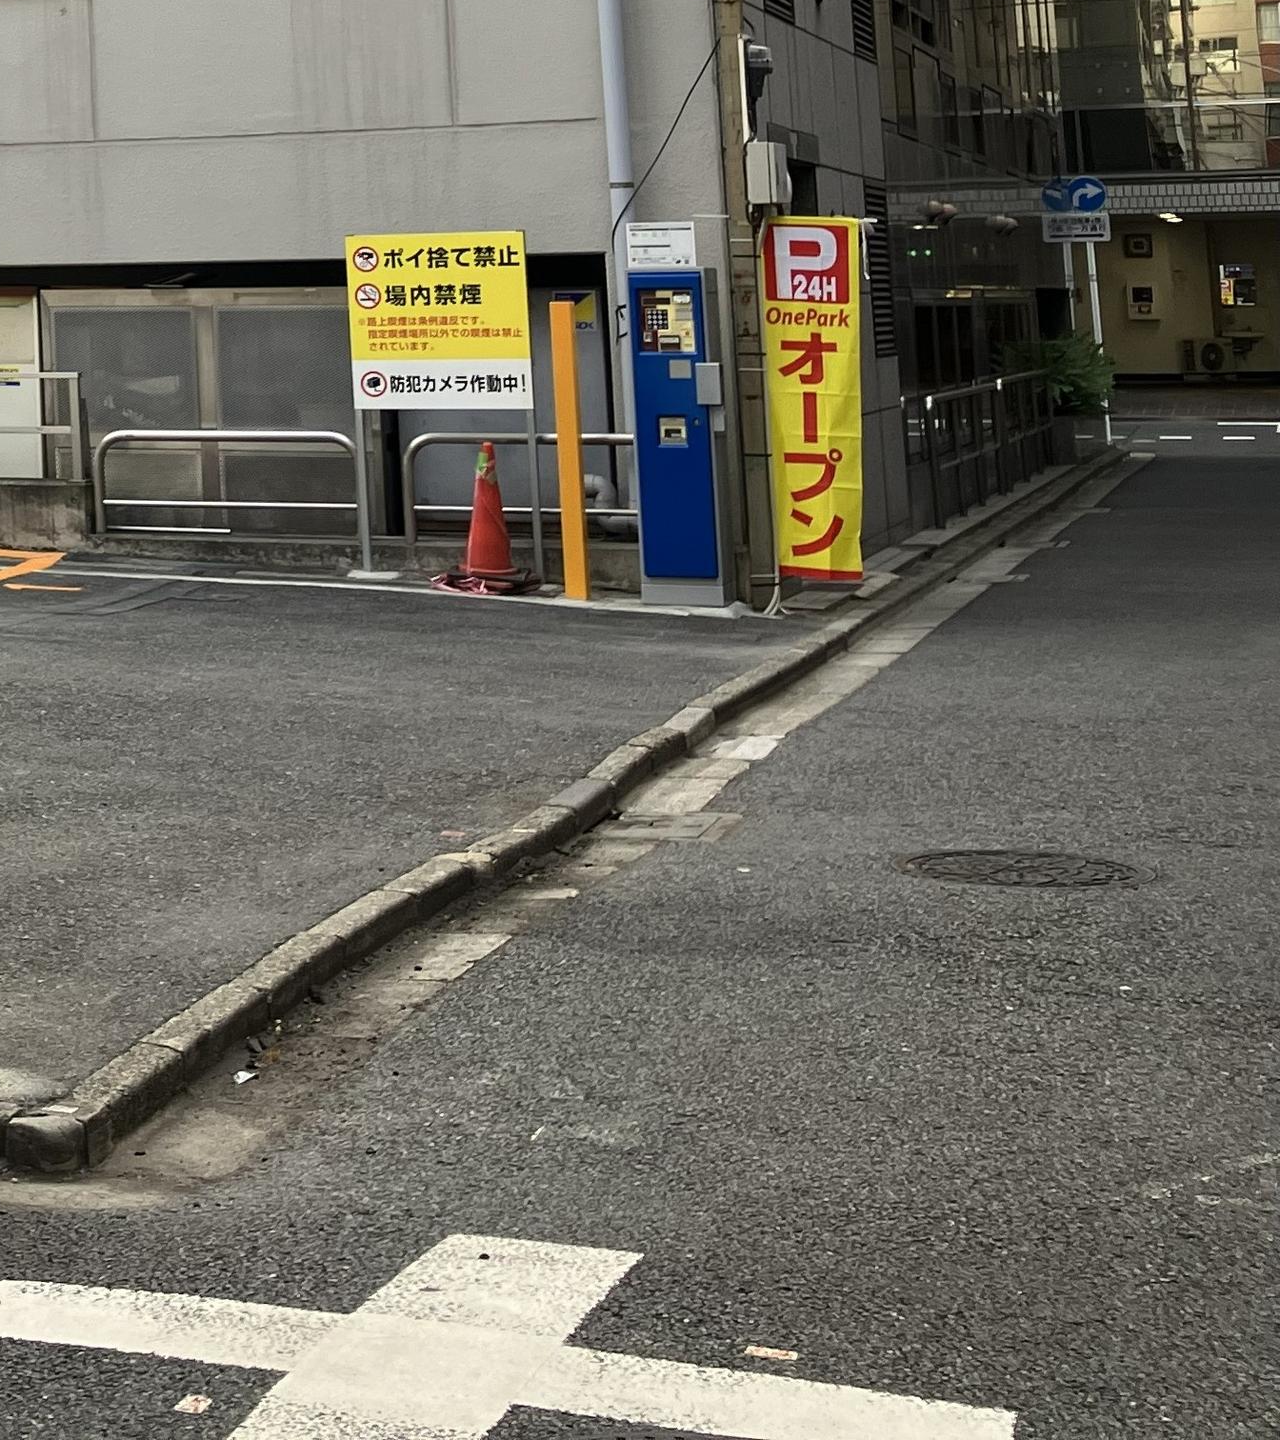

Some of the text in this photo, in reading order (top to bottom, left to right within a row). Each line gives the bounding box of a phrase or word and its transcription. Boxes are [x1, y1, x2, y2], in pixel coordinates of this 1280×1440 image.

[383, 245, 520, 268] ポイ捨て禁止
[385, 284, 482, 306] 場内禁煙
[766, 307, 850, 329] OnePark
[390, 374, 527, 393] 防犯カメラ作動中!
[778, 333, 845, 557] オープン
